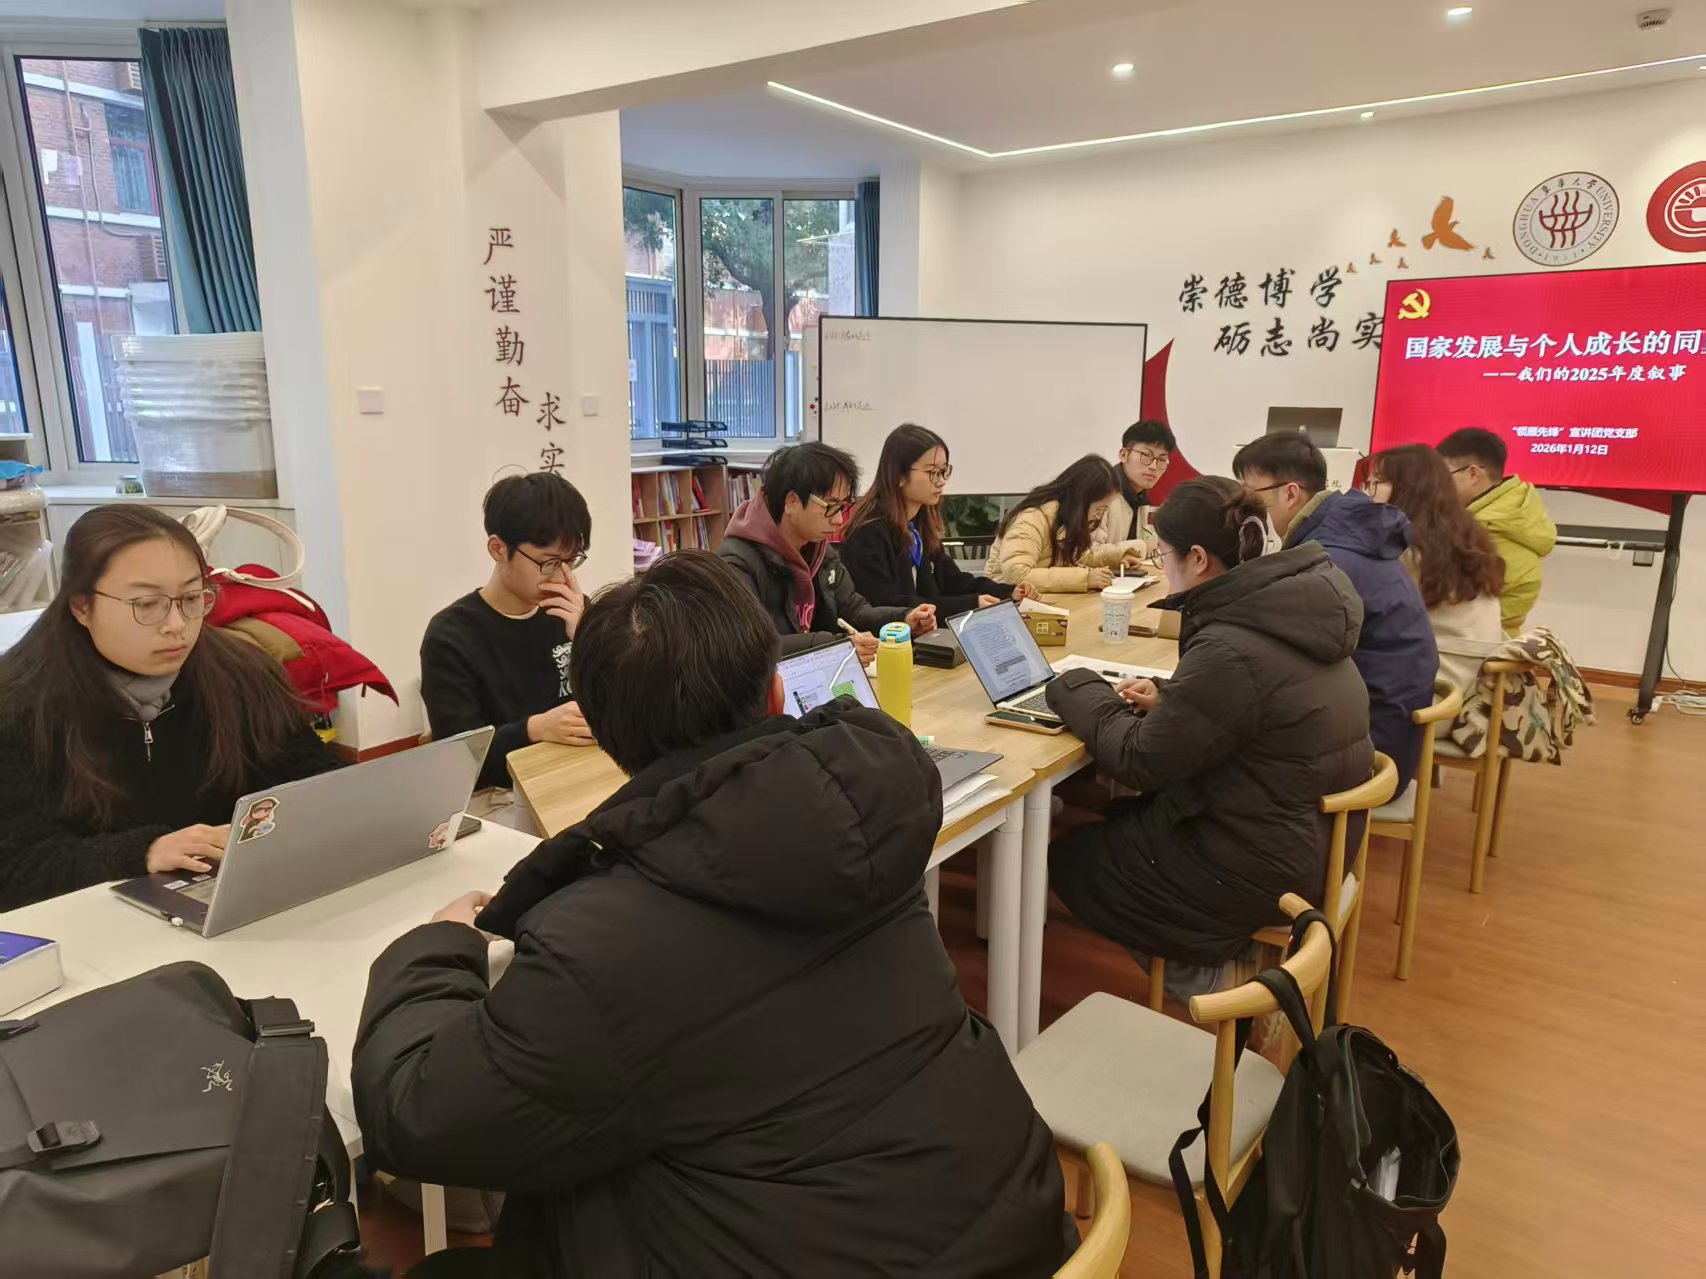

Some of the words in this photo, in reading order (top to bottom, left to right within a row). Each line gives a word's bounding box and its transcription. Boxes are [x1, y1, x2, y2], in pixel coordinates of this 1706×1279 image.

[1519, 196, 1540, 256] DONGHUA
[1587, 186, 1615, 250] UNIVERSITY
[1179, 265, 1343, 313] 崇德博学
[483, 227, 531, 417] 严谨勤奋
[1213, 312, 1385, 357] 砺志尚实
[1405, 328, 1706, 360] 国家发展与个人成长的同
[536, 391, 567, 476] 求实
[1530, 443, 1609, 456] 2026年1月12日
